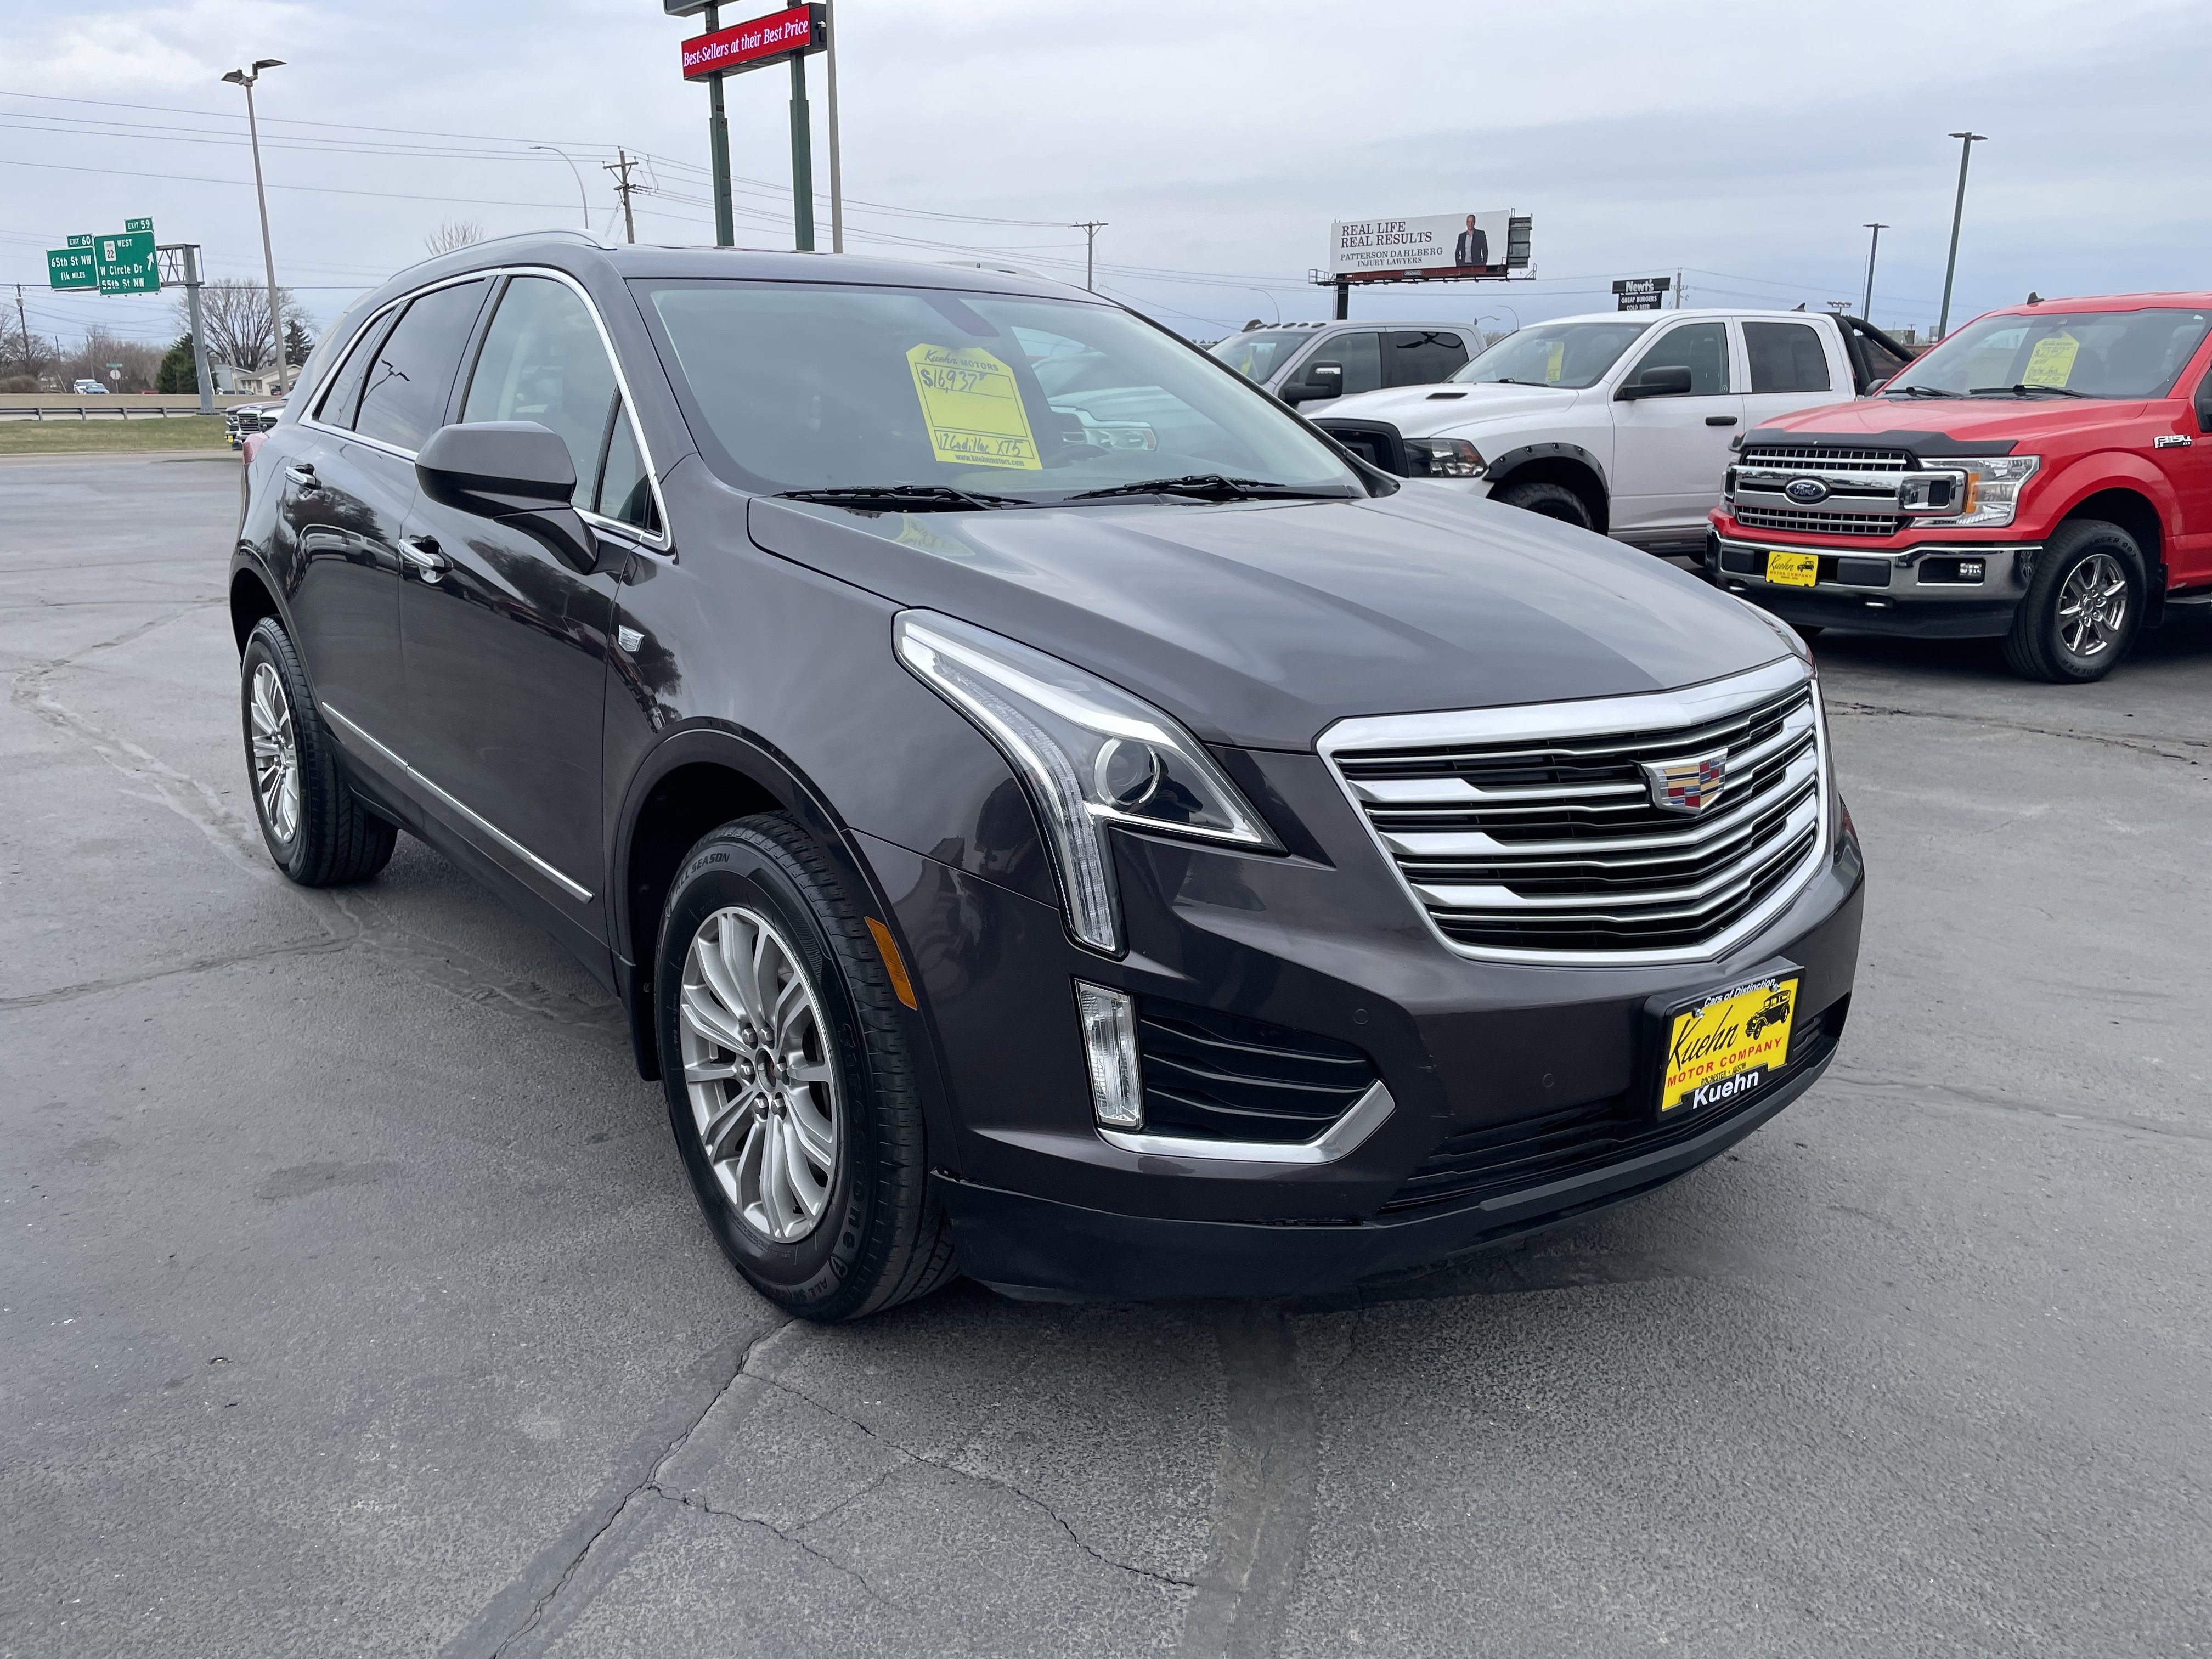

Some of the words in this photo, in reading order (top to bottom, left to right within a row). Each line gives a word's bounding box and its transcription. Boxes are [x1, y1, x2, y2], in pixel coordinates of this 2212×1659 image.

[684, 43, 729, 67] Best-Sellers
[731, 42, 740, 53] at
[741, 31, 761, 51] their
[763, 27, 782, 45] Best
[784, 19, 808, 40] Price
[127, 222, 138, 230] EXIT
[140, 219, 150, 229] 59
[1342, 223, 1373, 236] REAL
[1376, 221, 1406, 234] LIFE
[82, 236, 91, 246] 60
[117, 239, 132, 248] WEST
[1341, 236, 1373, 248] REAL
[1376, 231, 1432, 246] RESULTS
[106, 249, 115, 258] 22
[1340, 251, 1388, 261] PATTERSON
[1390, 247, 1443, 258] DAHLBERG
[51, 257, 68, 268] 65th
[70, 256, 79, 266] St
[81, 255, 92, 264] NW
[1357, 259, 1385, 267] INJURY
[1386, 257, 1423, 266] LAWYERS
[100, 266, 106, 276] W
[109, 263, 131, 275] Circle
[134, 263, 143, 273] Dr
[101, 279, 119, 290] 55th
[122, 278, 130, 289] St
[133, 277, 144, 287] NW
[1626, 279, 1654, 292] Newt's
[924, 349, 957, 364] Kuehn
[960, 359, 999, 371] MOTORS
[955, 454, 1025, 466] www.kuehnmotors.com
[1794, 484, 1815, 495] Ford
[1769, 554, 1795, 571] Kuehn
[691, 853, 730, 874] SEASON
[1704, 996, 1723, 1008] Cars
[1724, 989, 1735, 1000] of
[1734, 978, 1775, 996] Distinction
[1668, 1005, 1739, 1072] Kuehn
[1667, 1062, 1714, 1088] MOTOR
[1720, 1037, 1782, 1068] COMPANY
[1701, 1070, 1726, 1086] ROCHESTER
[1731, 1062, 1746, 1075] AUSTIN
[1692, 1071, 1759, 1109] Kuehn
